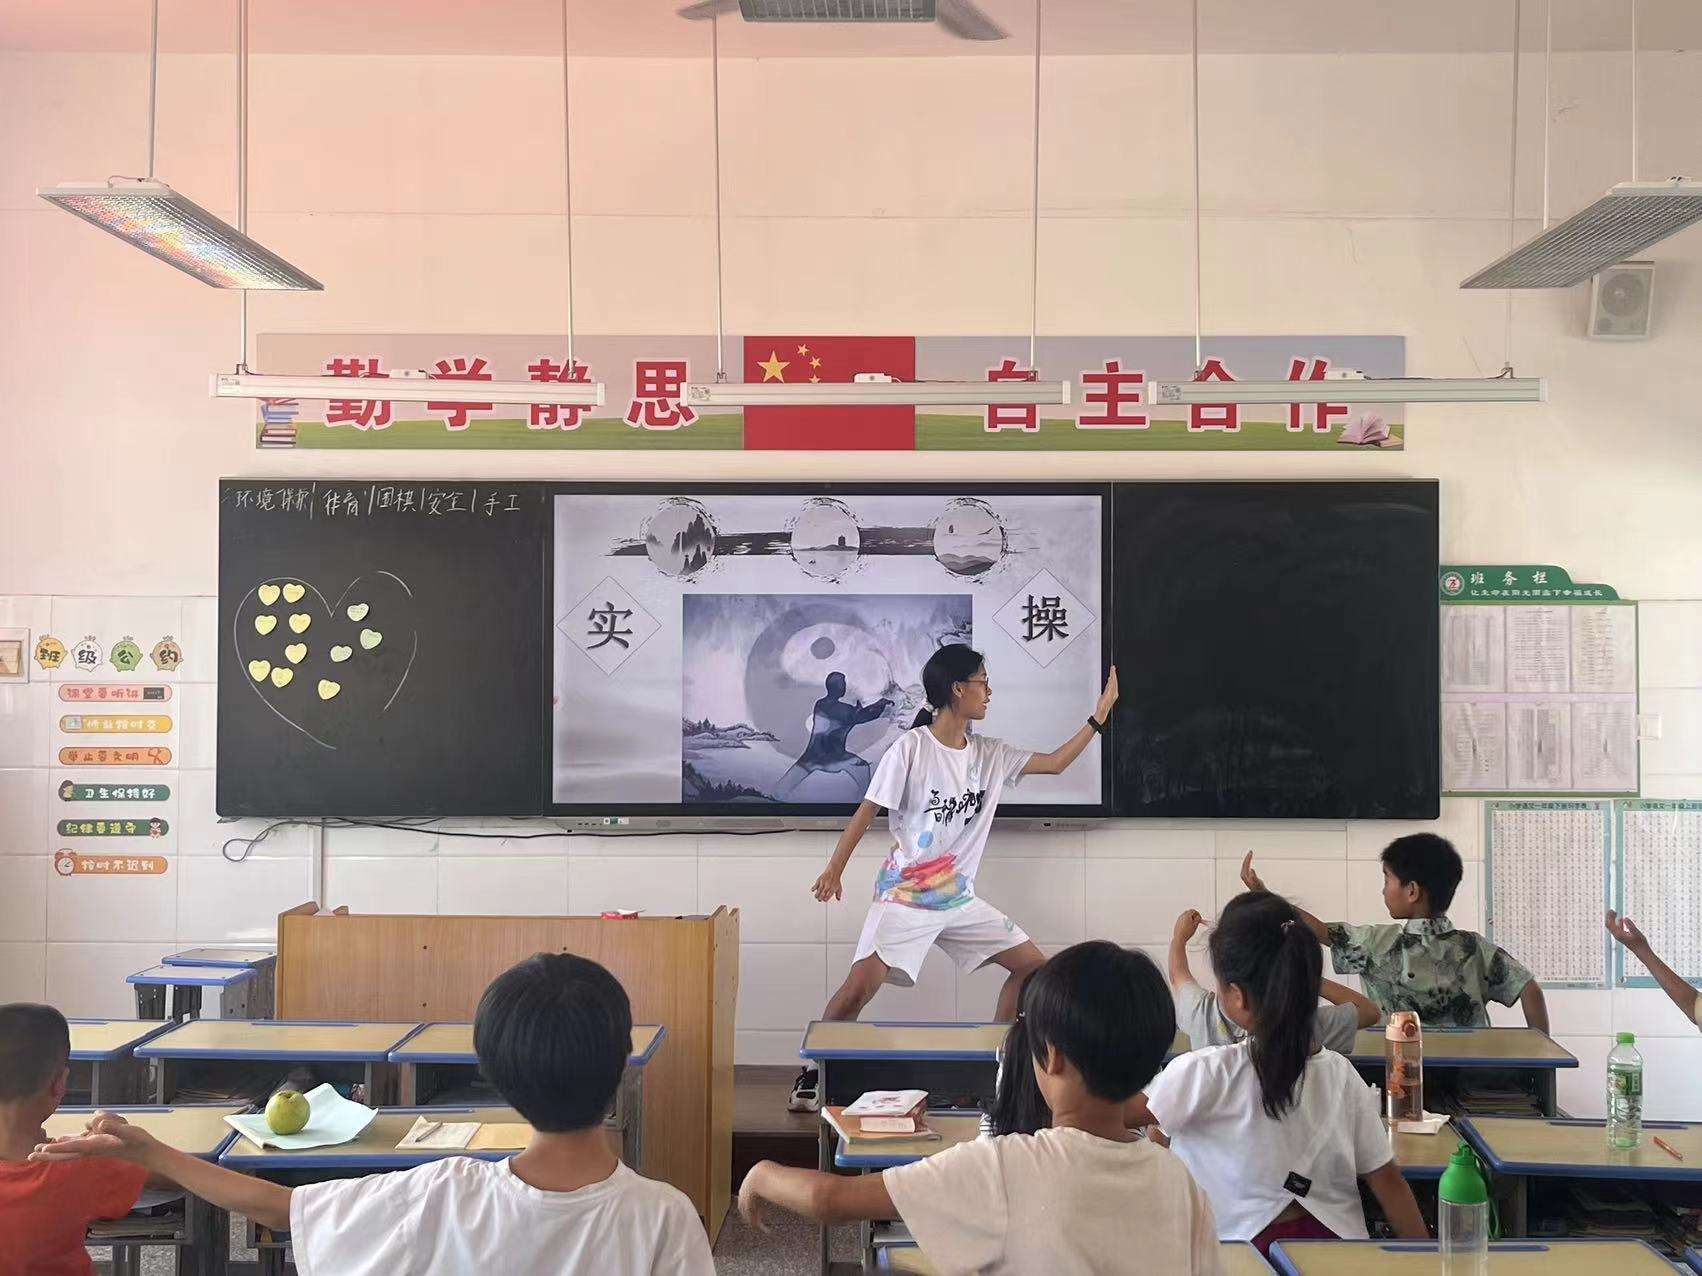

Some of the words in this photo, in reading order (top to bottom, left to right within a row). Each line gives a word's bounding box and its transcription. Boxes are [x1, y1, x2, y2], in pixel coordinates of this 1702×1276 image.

[324, 357, 696, 427] 勤学静思
[323, 489, 359, 516] 体育
[377, 487, 416, 512] 围棋
[428, 488, 467, 515] 安全
[483, 491, 520, 516] 手工
[1470, 571, 1548, 585] 班务栏
[586, 600, 634, 651] 实
[1021, 593, 1070, 643] 操
[39, 648, 179, 666] 班级公约
[84, 787, 156, 799] 卫生保持好
[81, 859, 154, 872] 按时不迟到
